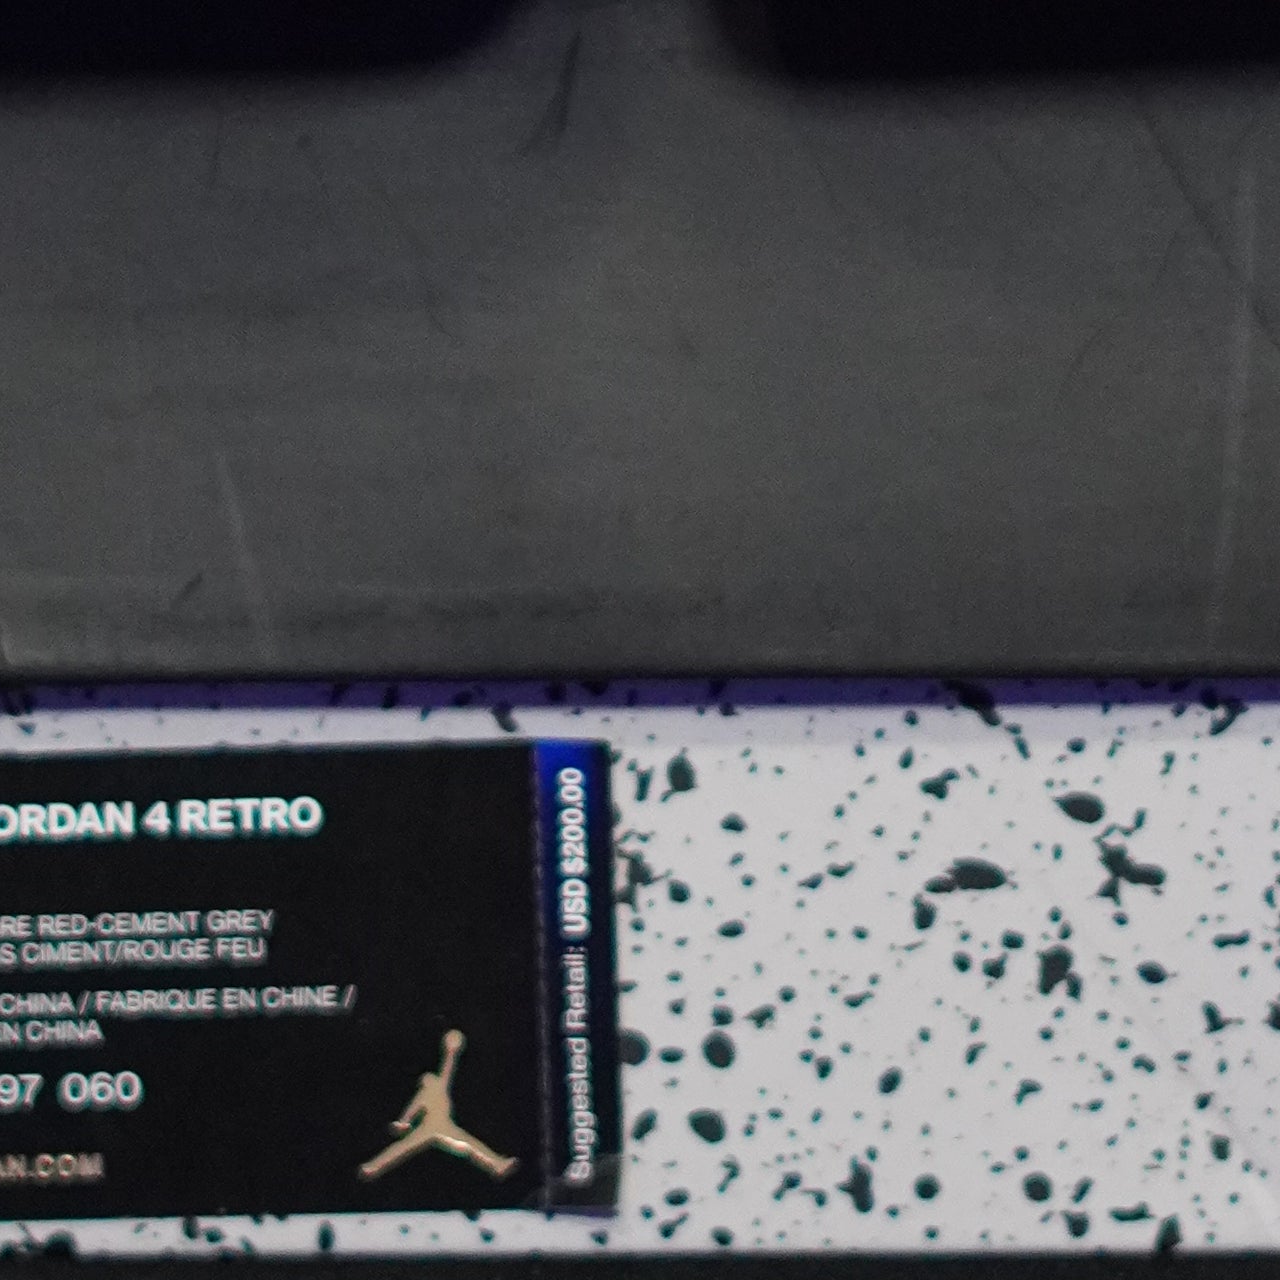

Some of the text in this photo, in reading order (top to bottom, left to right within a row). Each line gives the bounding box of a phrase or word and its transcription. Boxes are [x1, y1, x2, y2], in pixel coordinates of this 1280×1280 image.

[142, 800, 171, 836] 4
[176, 796, 324, 836] RETRO
[37, 911, 202, 938] RED-CEMENT
[206, 909, 276, 935] GREY
[21, 938, 212, 967] CIMENT/ROUGE
[215, 936, 267, 962] FEU
[556, 766, 598, 1185] Suggested Retail: USD $200.00
[94, 987, 218, 1015] FABRIQUE
[222, 987, 258, 1013] EN
[260, 985, 340, 1012] CHINE
[23, 1017, 105, 1046] CHINA
[55, 1070, 145, 1112] 060
